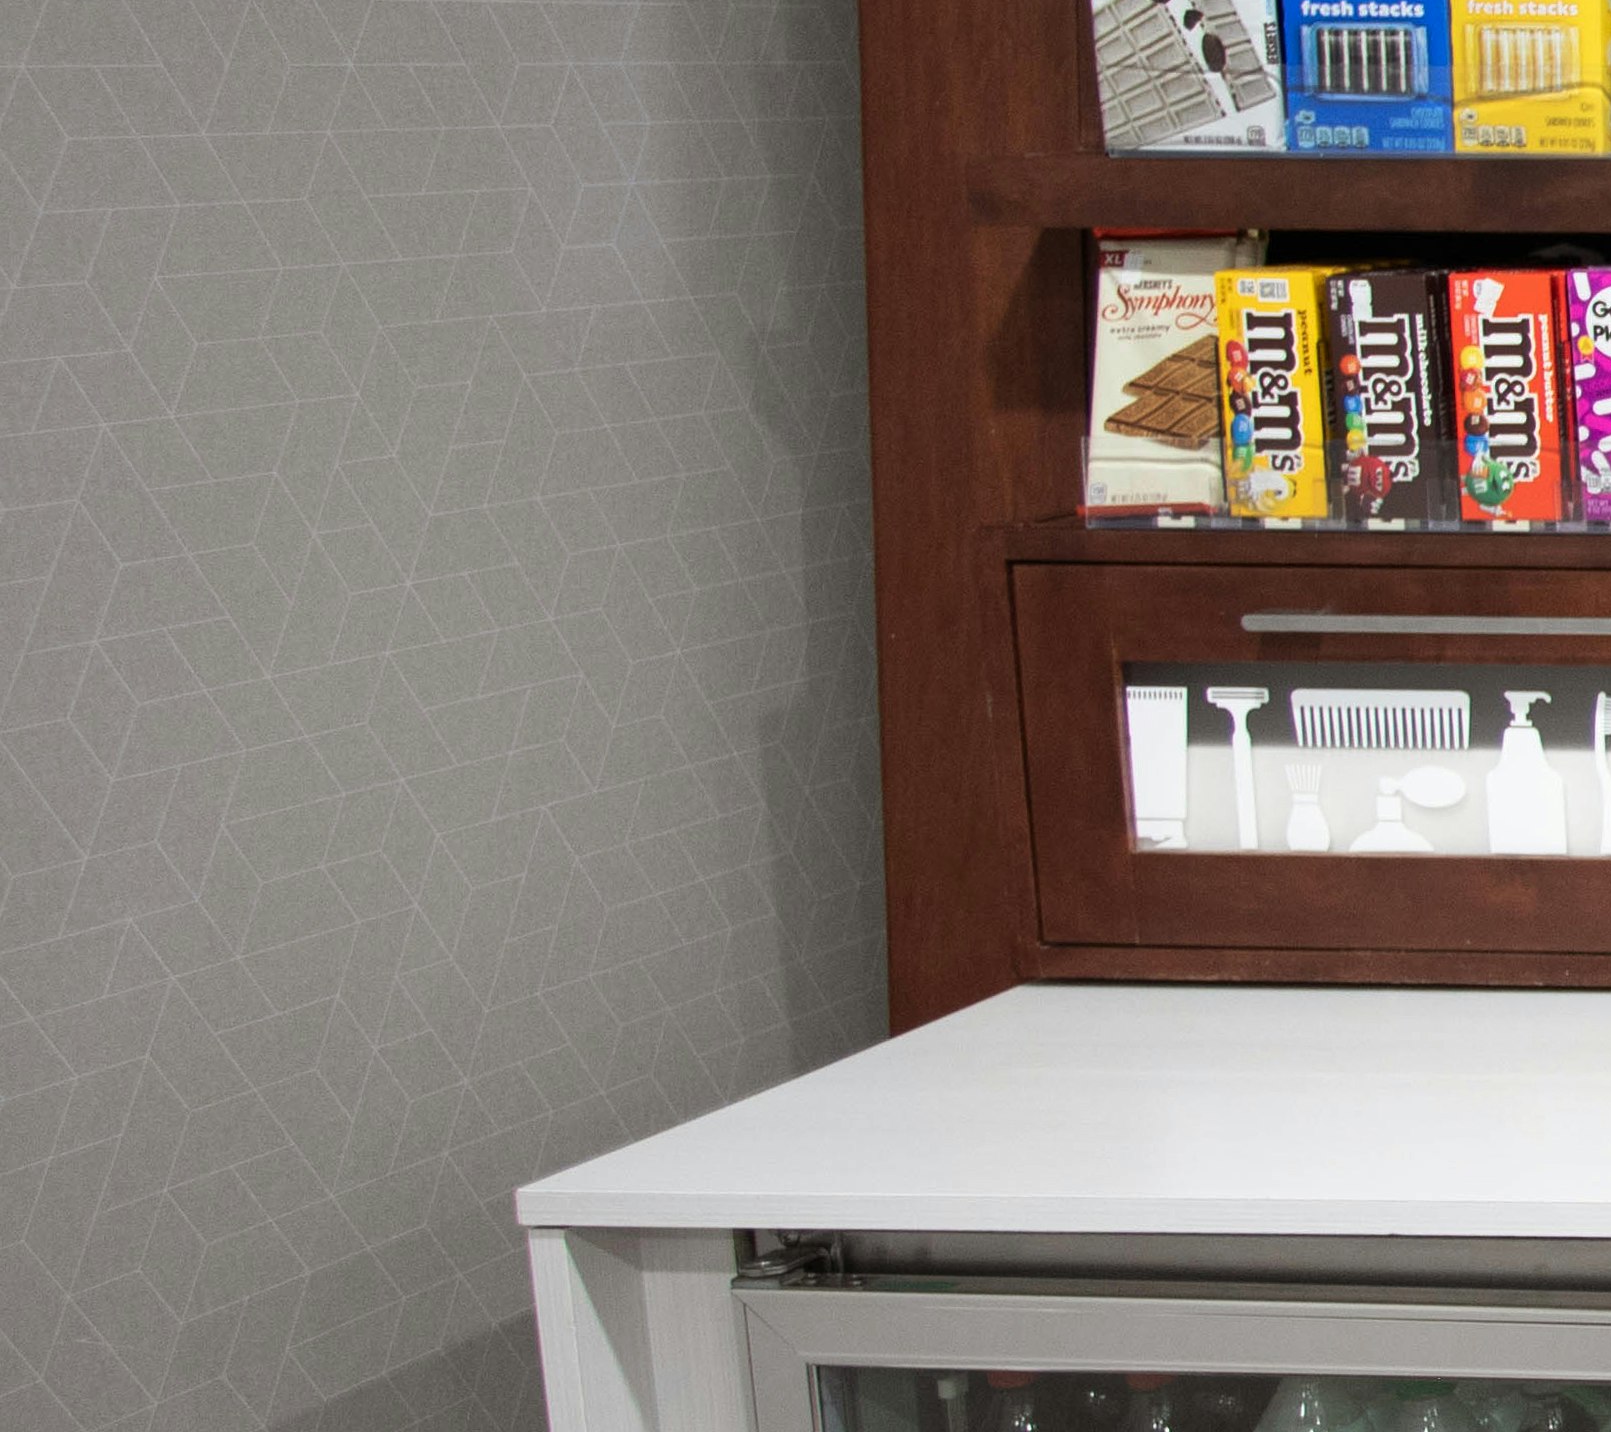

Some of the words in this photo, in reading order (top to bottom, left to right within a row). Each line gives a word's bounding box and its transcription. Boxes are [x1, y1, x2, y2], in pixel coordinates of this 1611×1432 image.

[1301, 0, 1354, 17] fresh
[1358, 0, 1425, 17] stacks
[1467, 0, 1521, 16] fresh
[1527, 0, 1578, 16] stacks
[1104, 254, 1124, 265] XL
